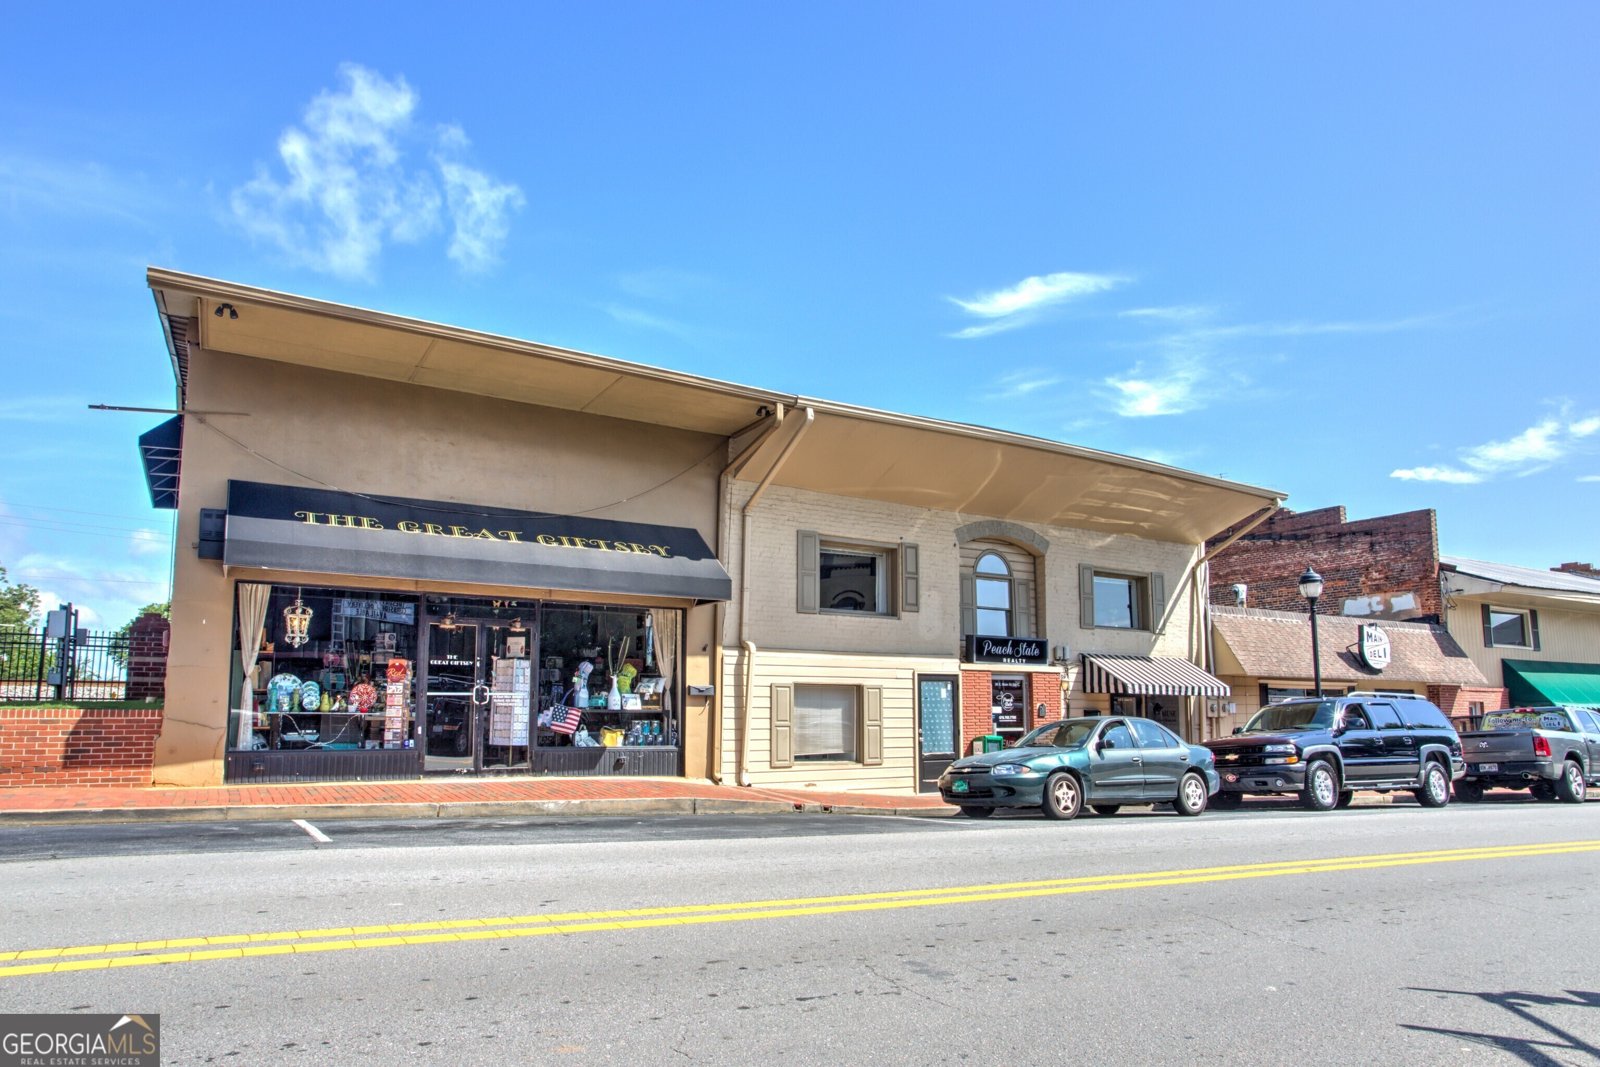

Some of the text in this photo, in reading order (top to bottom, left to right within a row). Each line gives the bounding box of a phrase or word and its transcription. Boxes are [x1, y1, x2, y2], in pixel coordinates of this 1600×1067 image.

[294, 510, 671, 558] THE GREAT GIFTSBY
[983, 639, 1040, 658] Peach State
